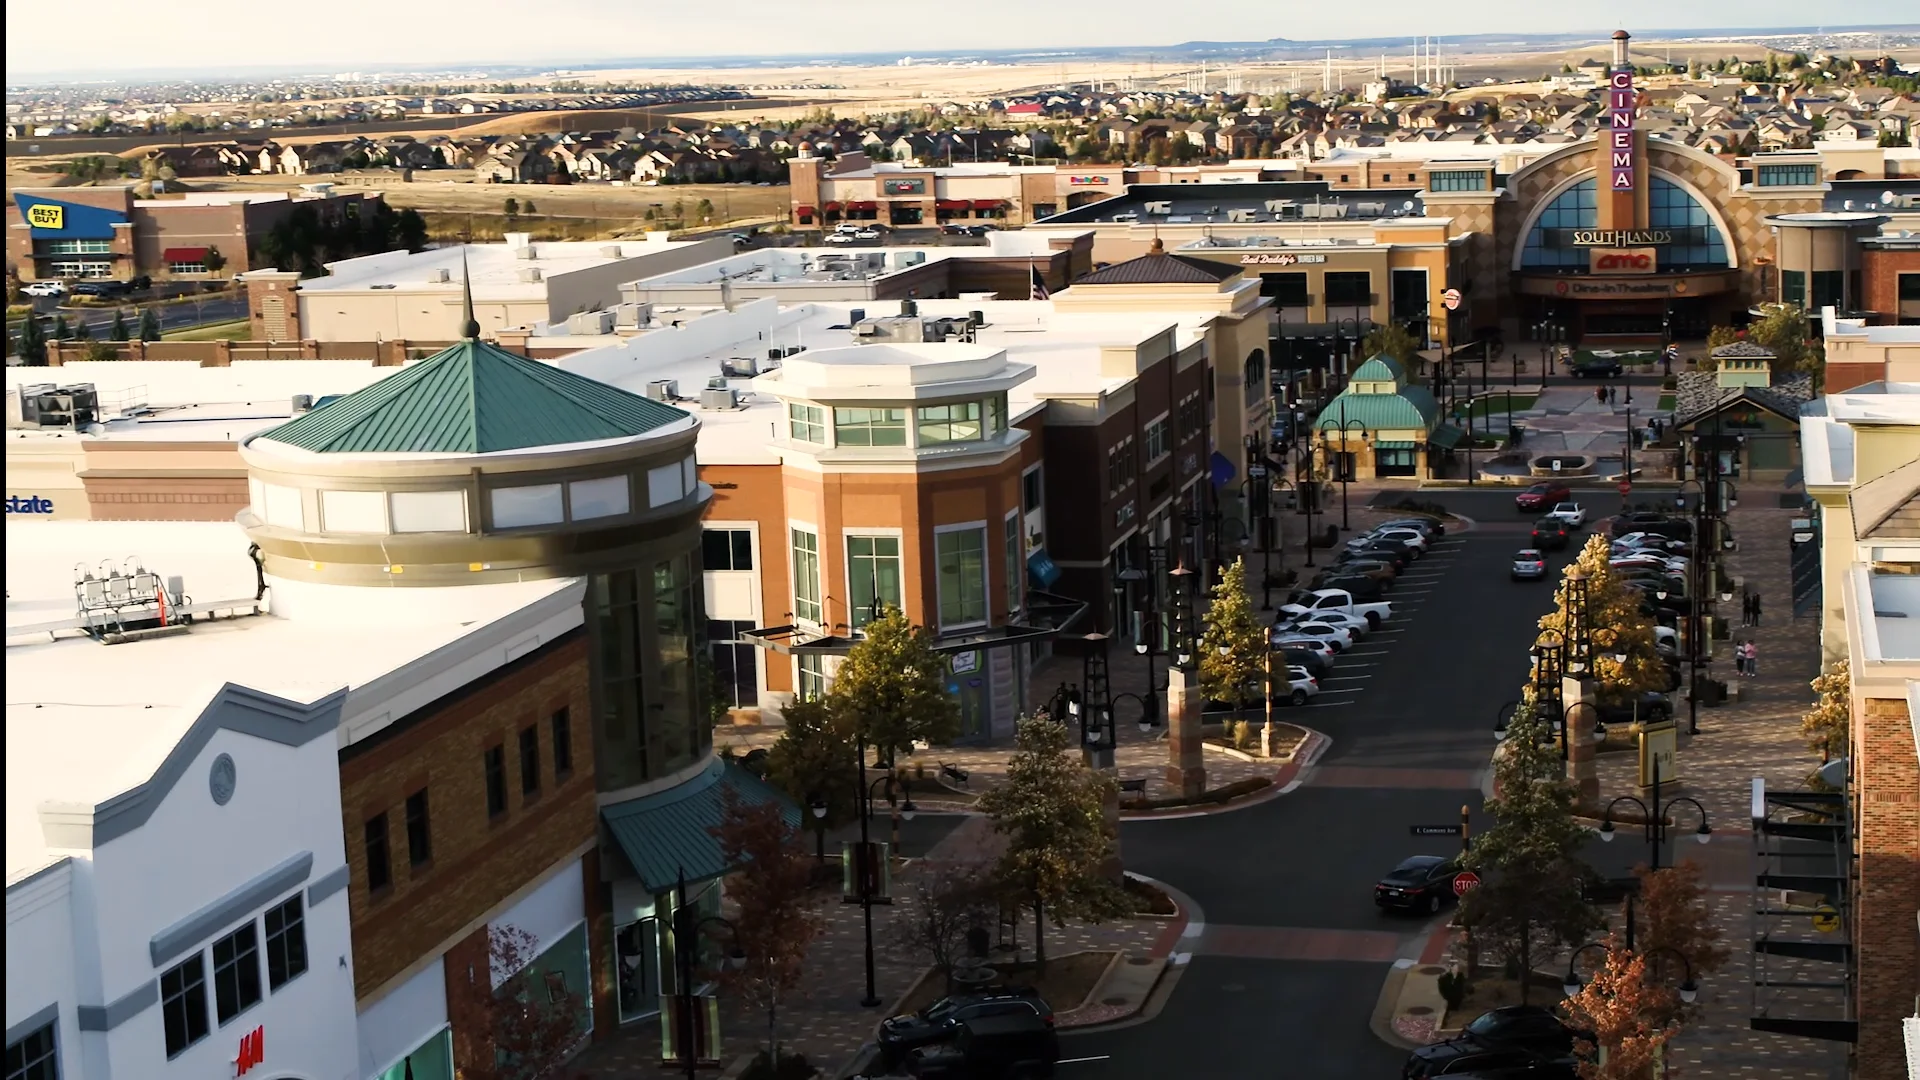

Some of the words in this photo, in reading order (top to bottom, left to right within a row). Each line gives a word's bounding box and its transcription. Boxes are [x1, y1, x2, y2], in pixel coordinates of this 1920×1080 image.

[1613, 73, 1631, 187] CINEMA
[33, 208, 60, 217] BEST
[34, 215, 57, 224] BUY
[1573, 230, 1672, 247] SOUTHLANDS
[1240, 254, 1260, 264] Bad
[1260, 254, 1296, 266] Daddy's
